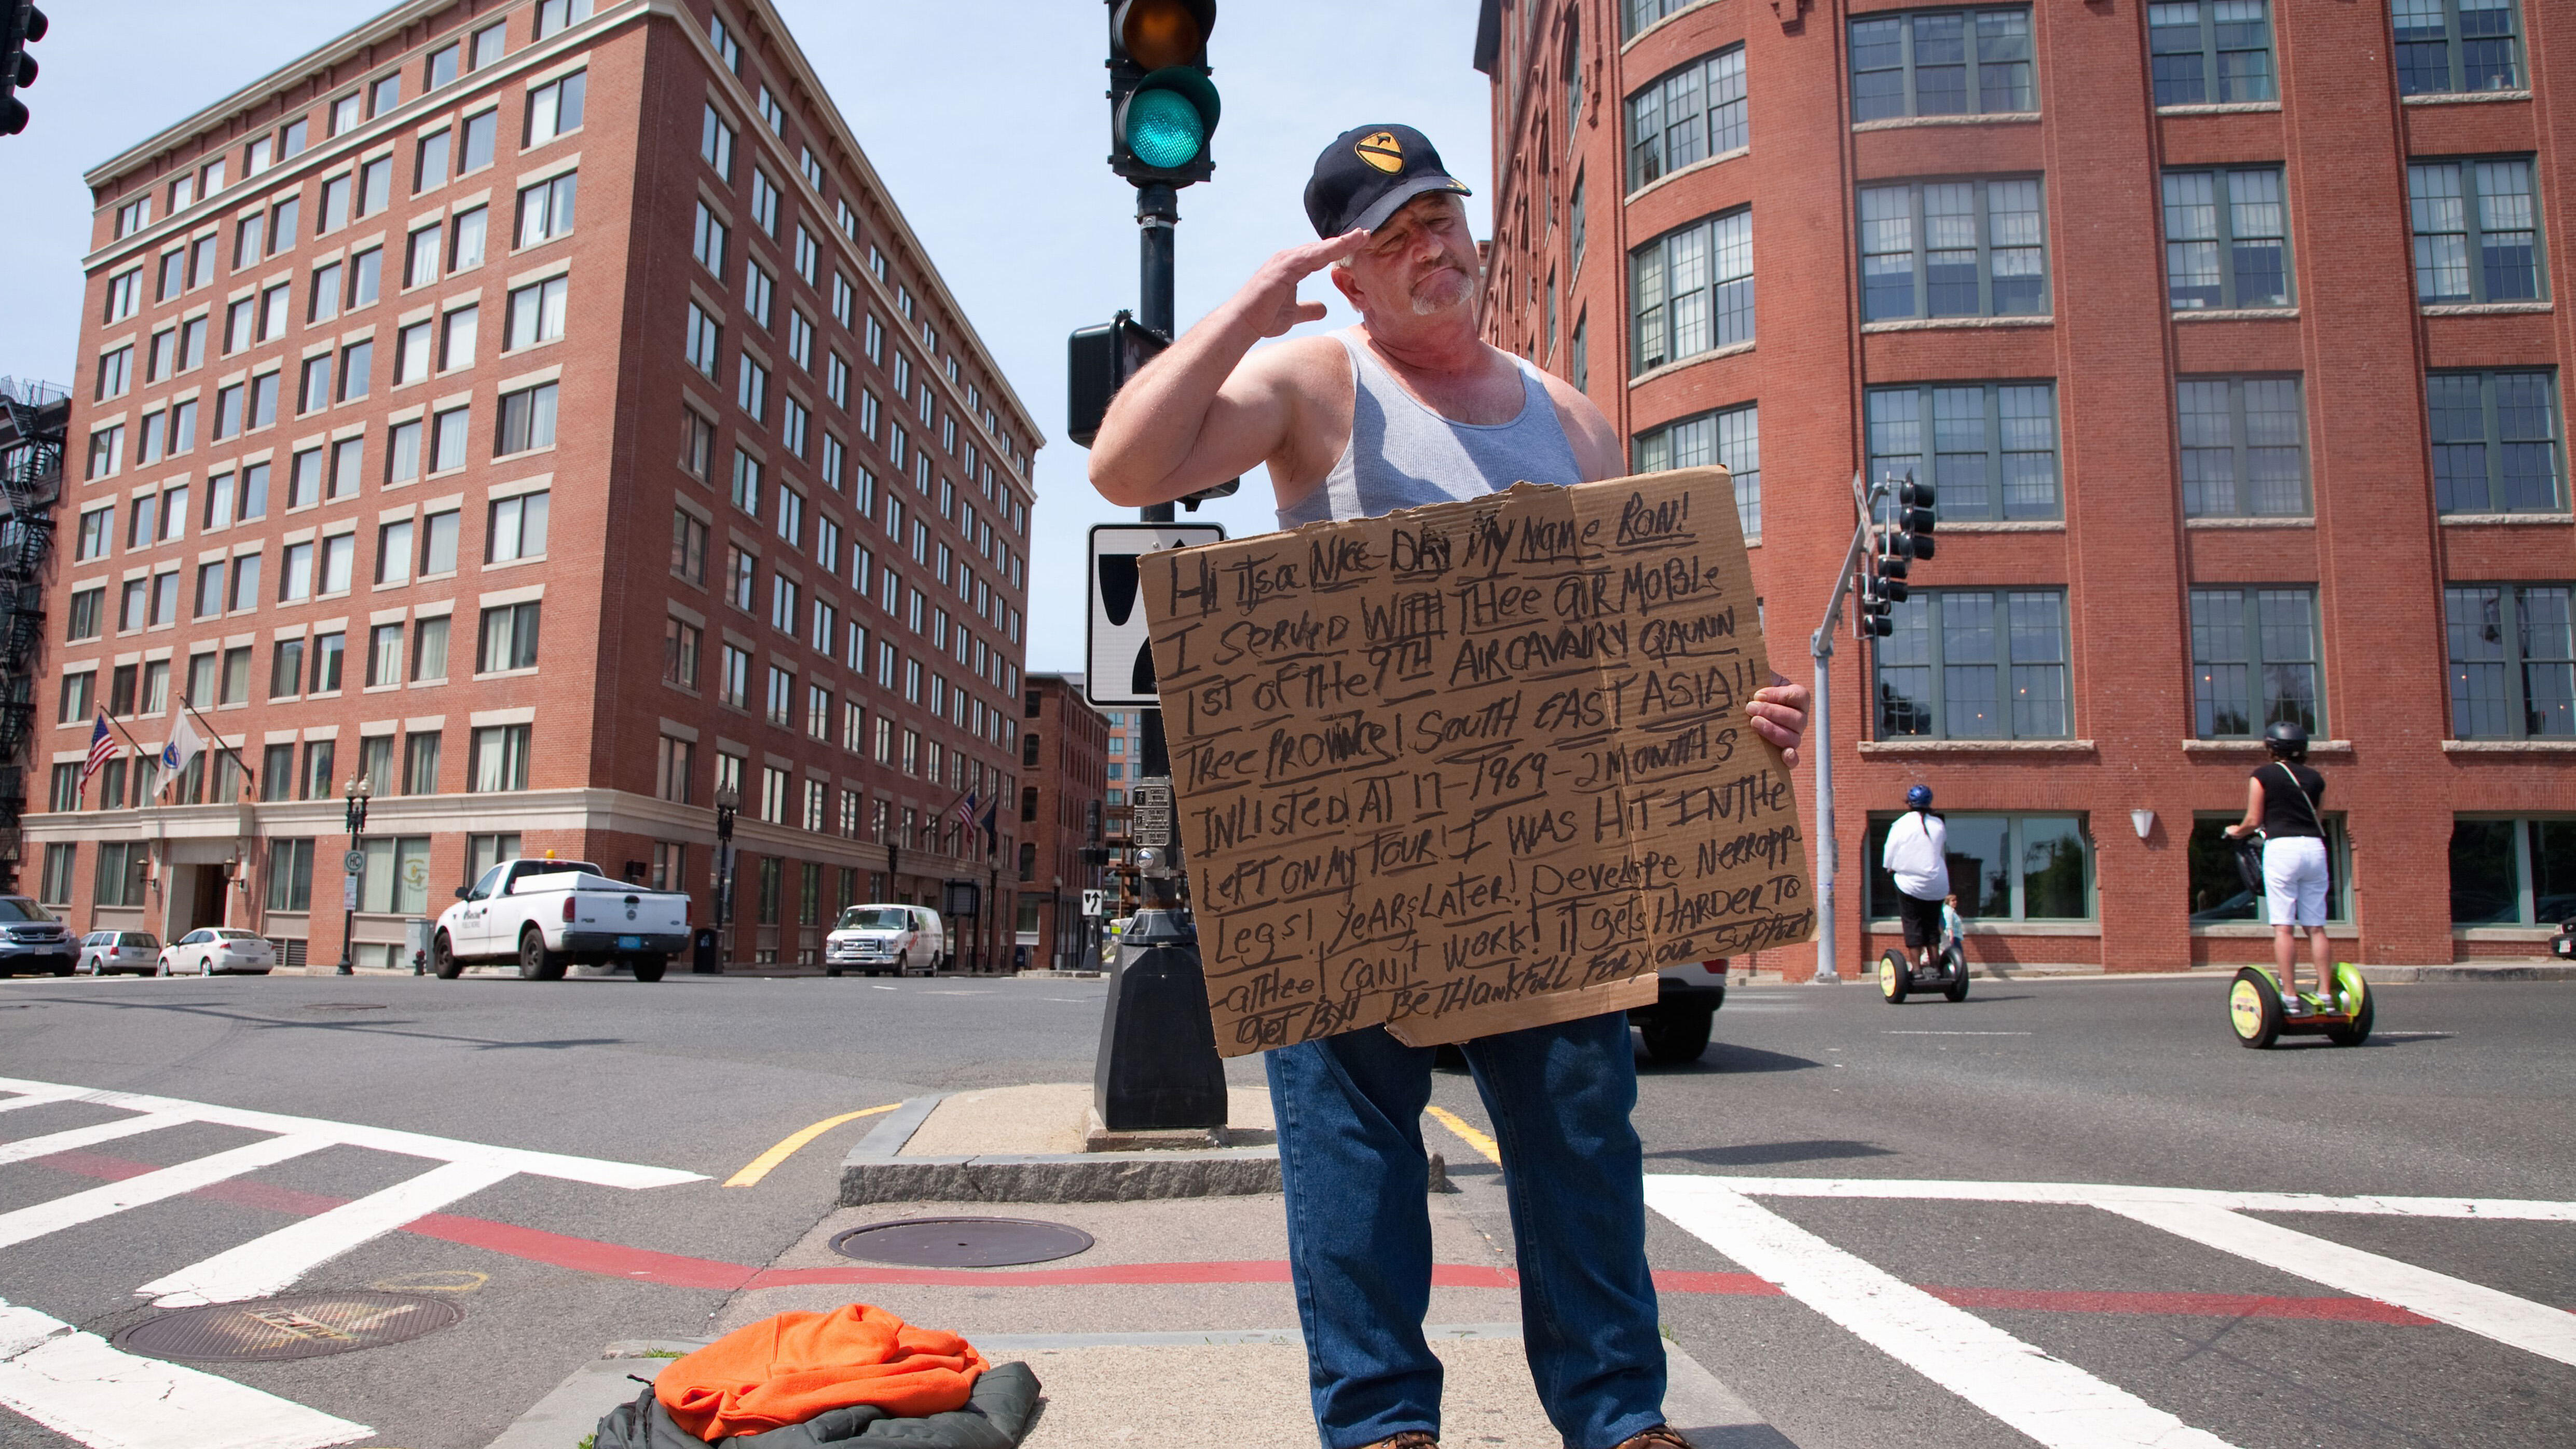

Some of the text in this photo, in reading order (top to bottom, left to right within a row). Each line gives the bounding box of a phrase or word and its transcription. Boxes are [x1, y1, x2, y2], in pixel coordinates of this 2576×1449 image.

[1169, 552, 1217, 618] Hi
[1154, 622, 1203, 681] I
[1449, 639, 1507, 686] AIR
[1508, 808, 1578, 855] WAS
[350, 855, 361, 867] HC
